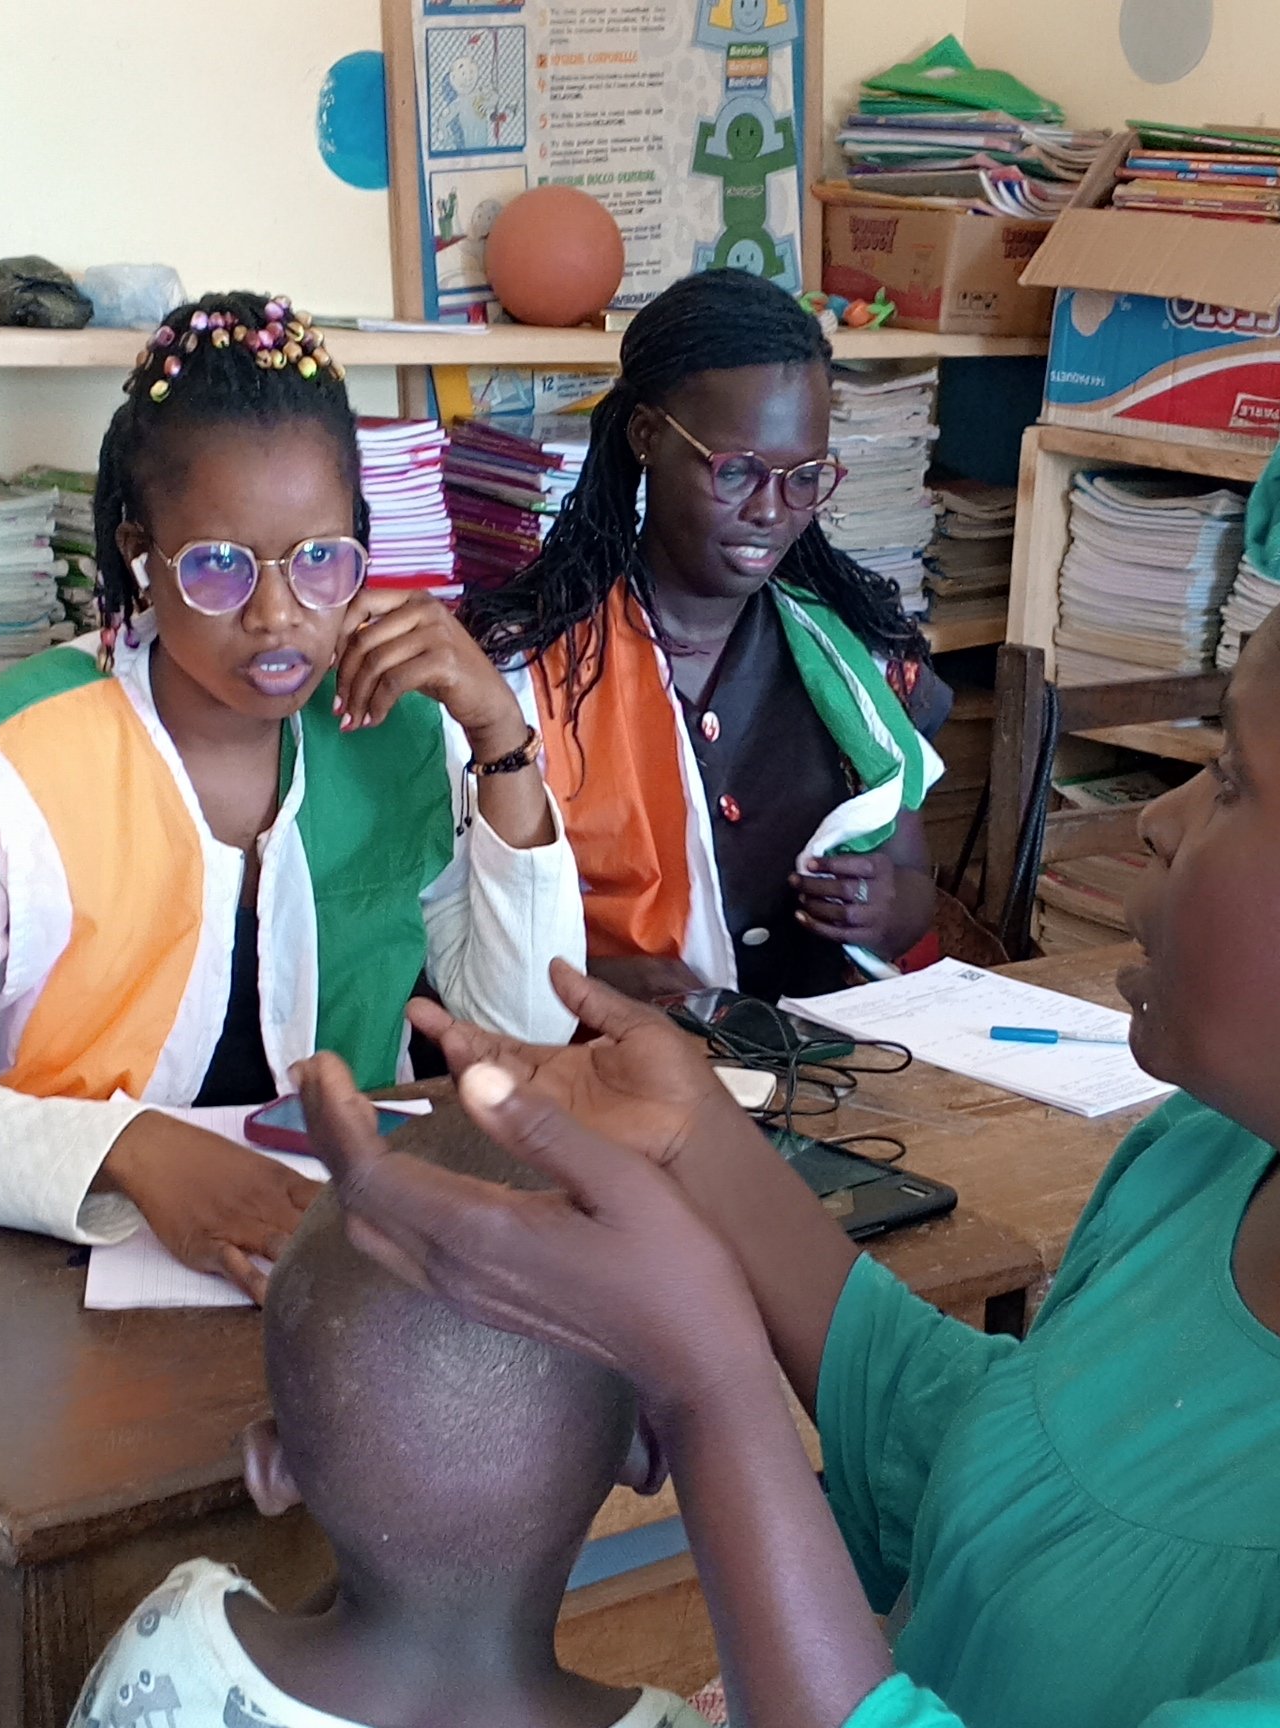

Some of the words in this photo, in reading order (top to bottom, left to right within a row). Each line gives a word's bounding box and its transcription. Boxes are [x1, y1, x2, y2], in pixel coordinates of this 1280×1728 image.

[542, 375, 554, 393] 12
[1050, 370, 1090, 387] PAQUETS
[1239, 404, 1280, 422] PARLE
